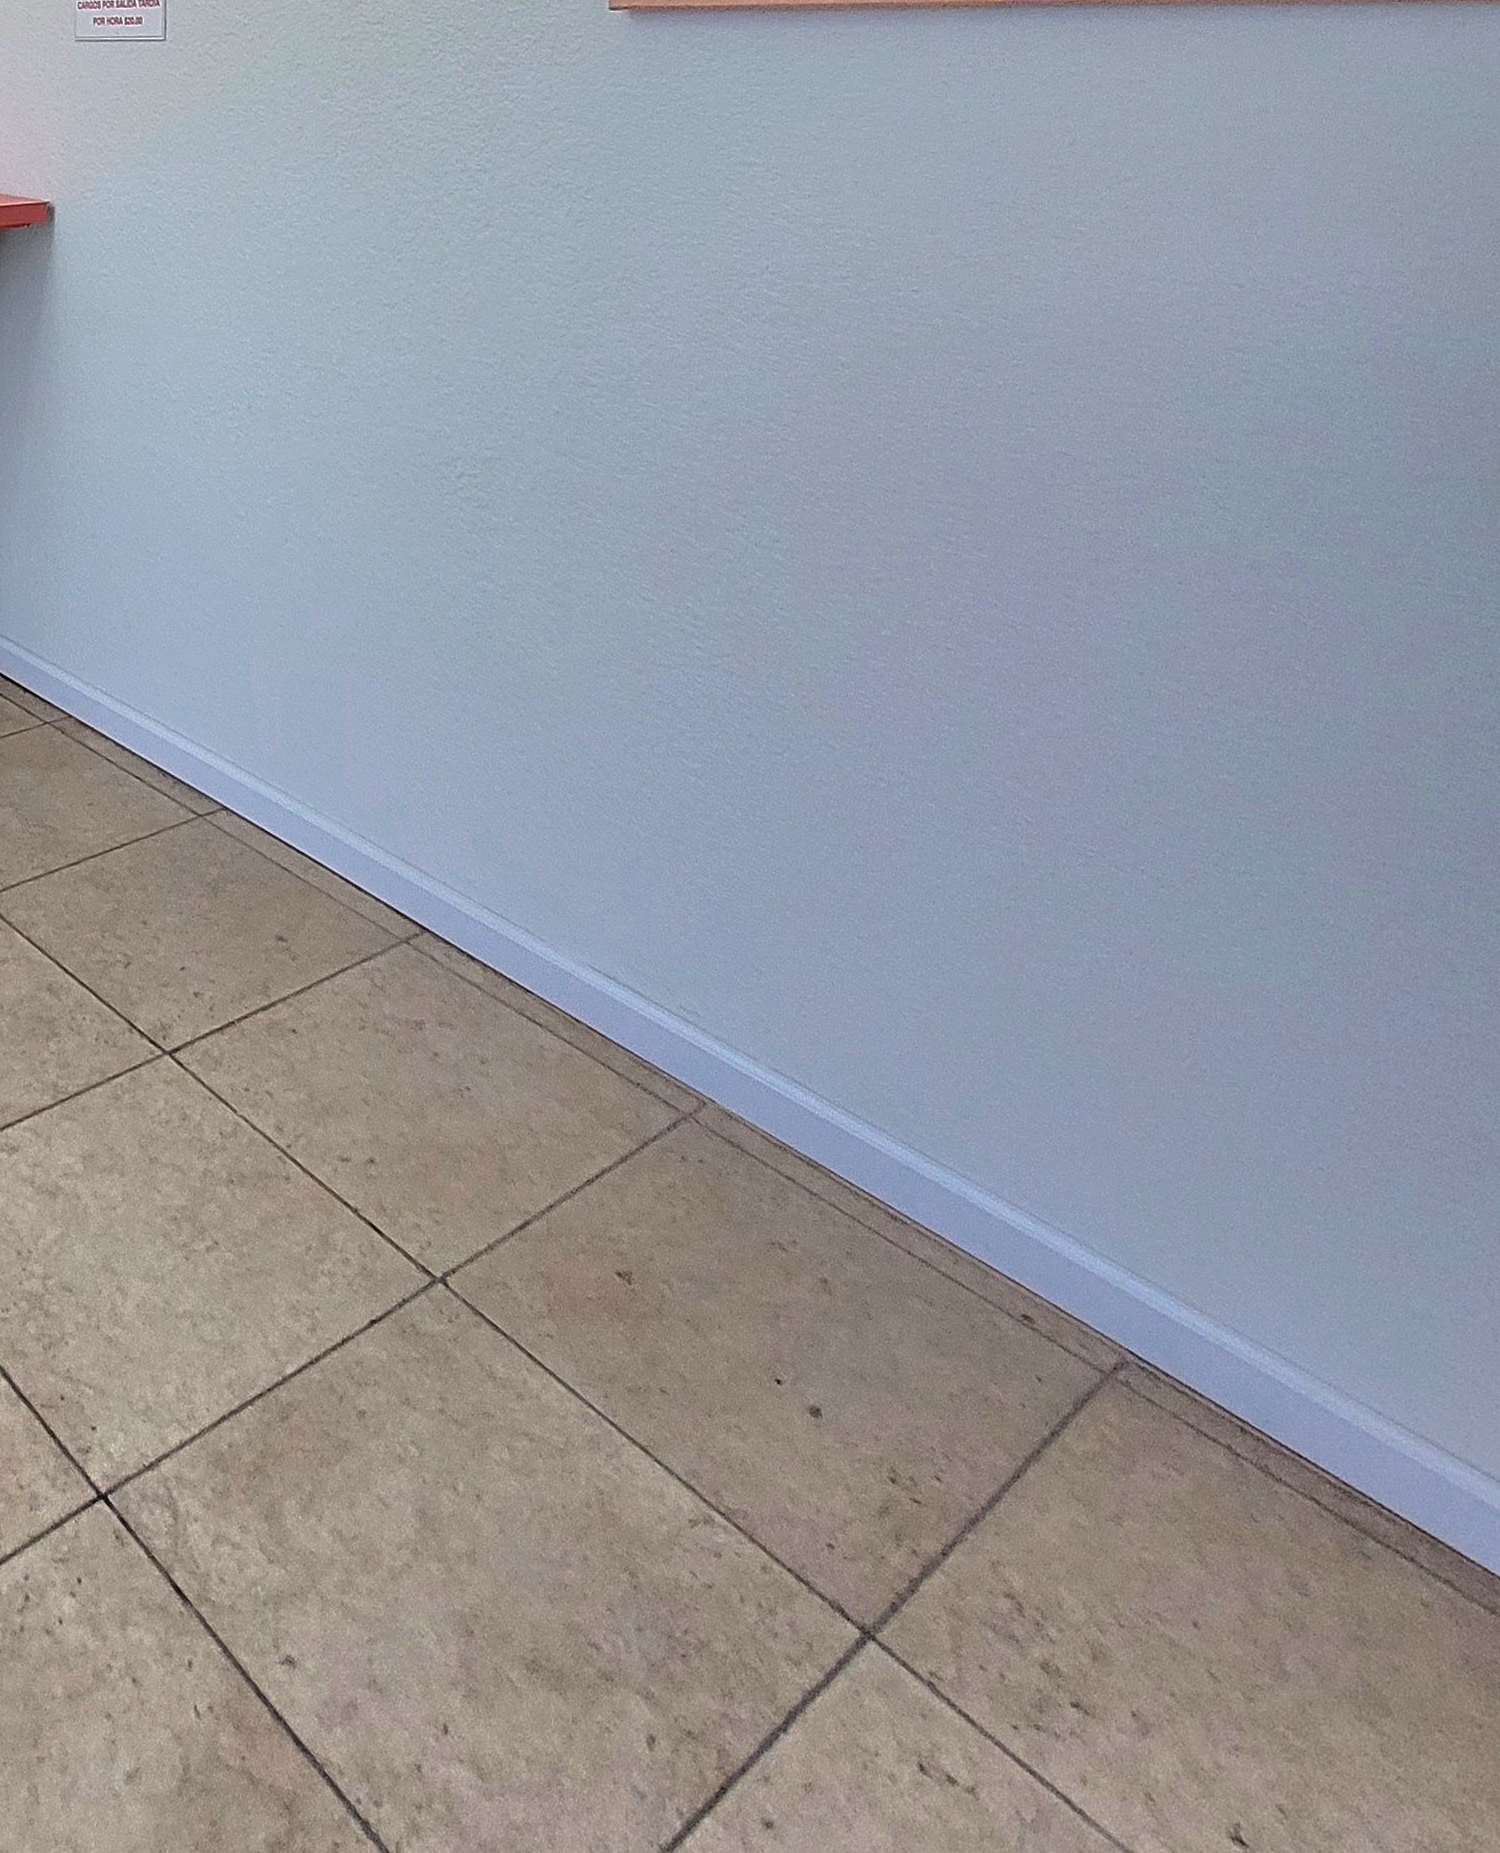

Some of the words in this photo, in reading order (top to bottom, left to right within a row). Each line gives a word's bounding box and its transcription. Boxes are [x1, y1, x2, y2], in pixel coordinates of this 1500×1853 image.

[77, 0, 101, 9] CARGOS
[102, 0, 114, 8] POR
[116, 0, 137, 8] SALIDA
[138, 0, 160, 7] TARDIA
[93, 17, 105, 25] POR
[107, 16, 123, 25] HORA
